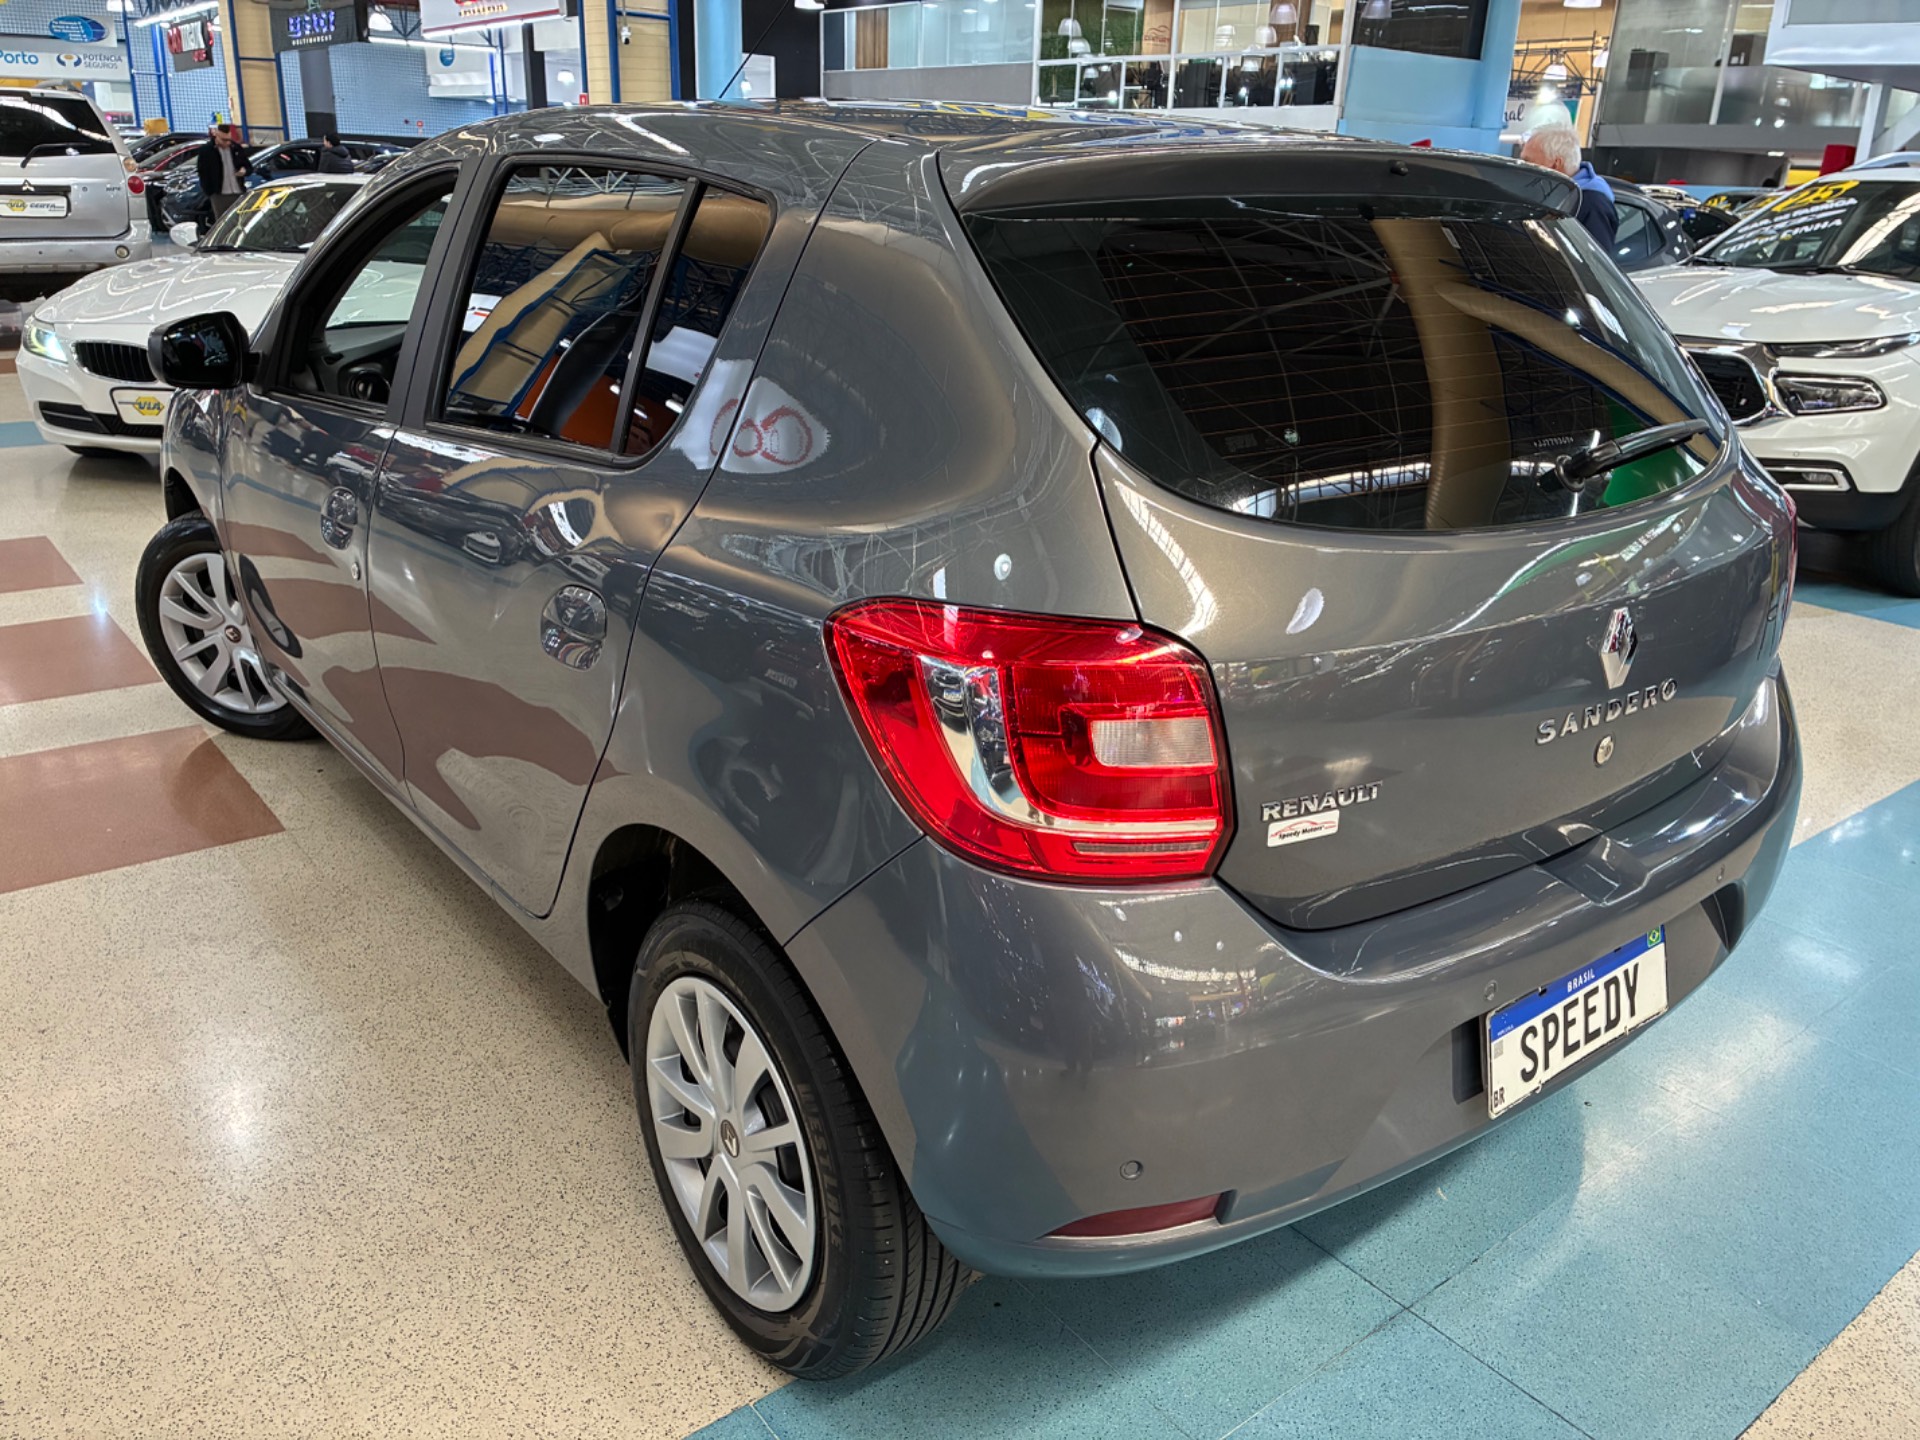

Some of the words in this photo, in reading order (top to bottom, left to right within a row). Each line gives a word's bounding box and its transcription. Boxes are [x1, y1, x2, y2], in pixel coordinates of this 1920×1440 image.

[1535, 678, 1677, 745] SANDERO
[1261, 780, 1383, 821] RENAULT
[1566, 968, 1596, 993] BRASIL
[1520, 962, 1639, 1083] SPEEDY
[1493, 1087, 1506, 1108] BR
